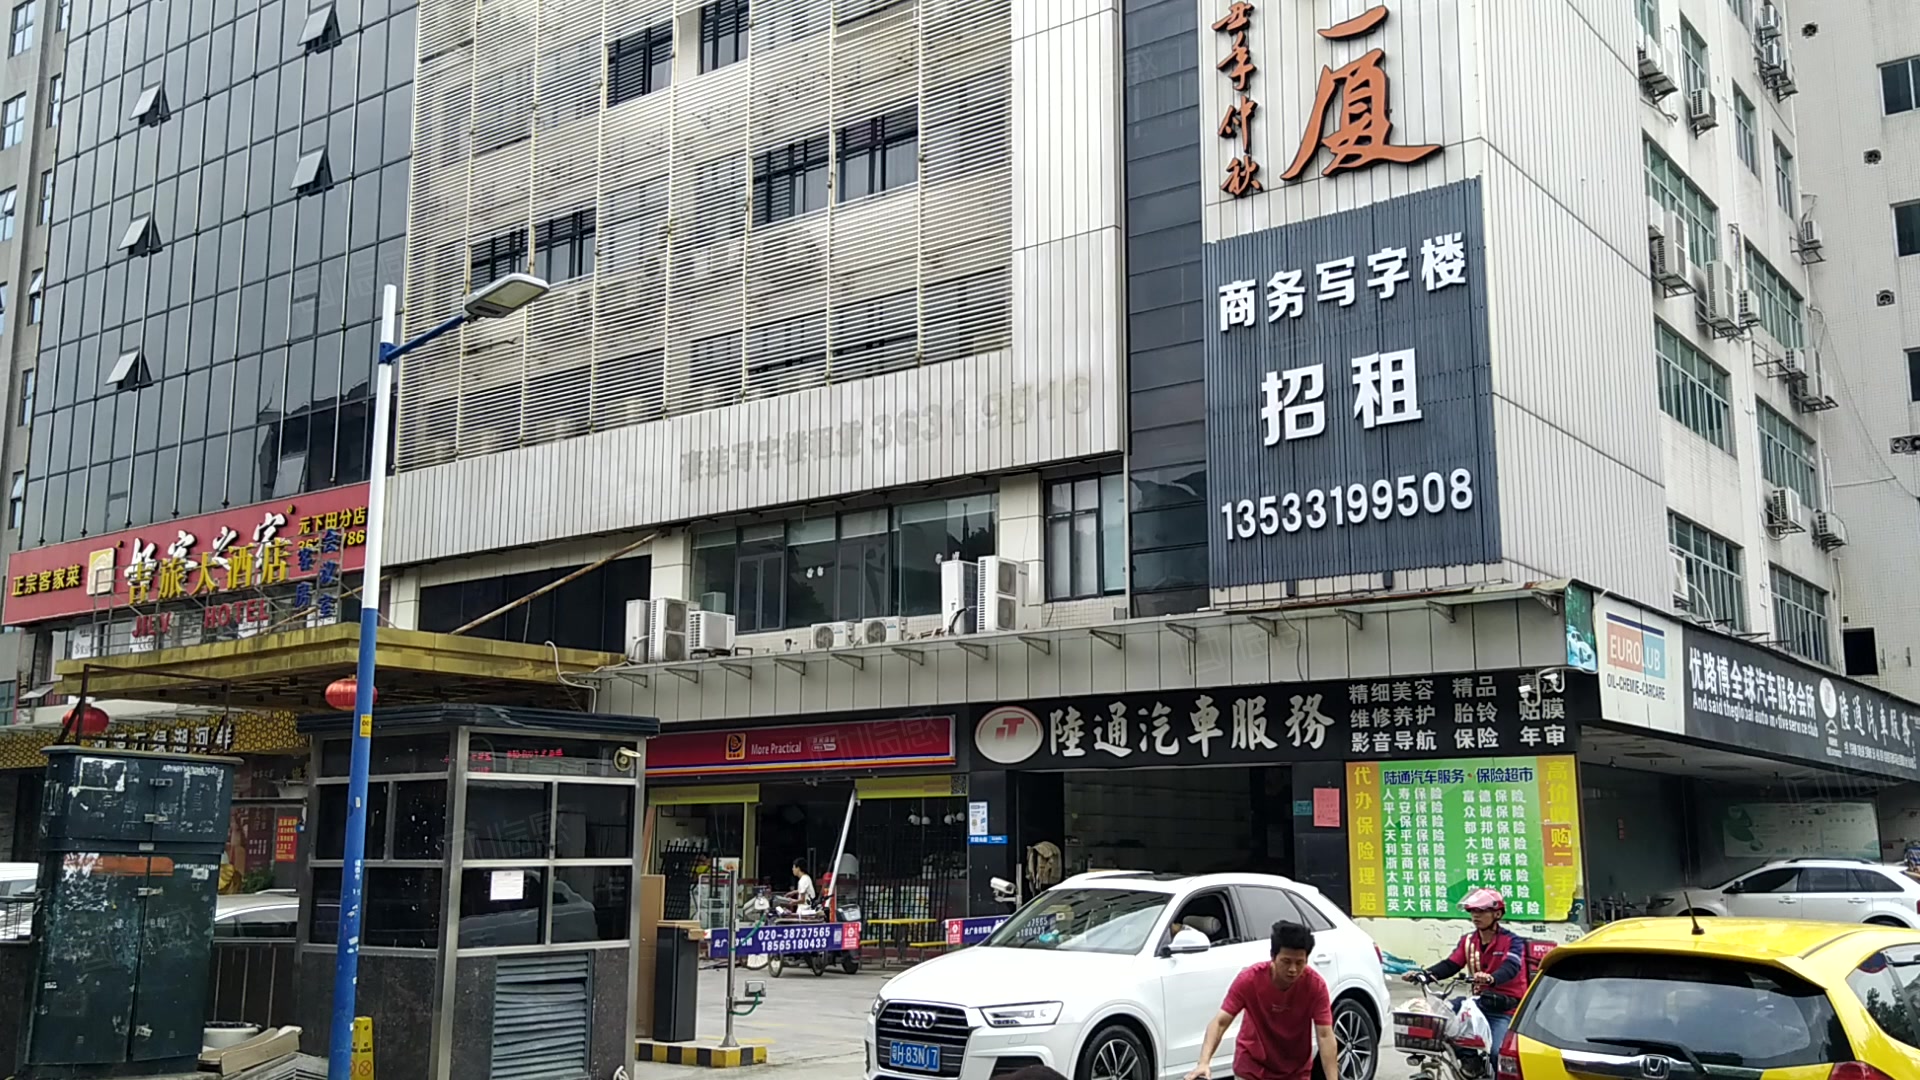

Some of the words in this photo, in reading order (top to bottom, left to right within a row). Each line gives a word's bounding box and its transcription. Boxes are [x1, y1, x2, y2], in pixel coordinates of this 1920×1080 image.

[1219, 231, 1467, 331] 商务写字楼
[1260, 347, 1423, 447] 招租
[1221, 467, 1473, 541] 13533199508
[298, 505, 366, 535] 元下田分店
[128, 537, 291, 605] 吉旅大酒店
[294, 546, 315, 608] 客房
[11, 564, 80, 597] 正宗客家菜
[204, 599, 269, 629] HOTEL
[1348, 678, 1435, 705] 精细美容
[1452, 675, 1498, 699] 精品
[1689, 646, 1817, 720] 优路博全球汽车服务会所
[1693, 691, 1708, 712] And
[1708, 696, 1723, 716] said
[1350, 704, 1436, 729] 维修养护
[1518, 698, 1566, 722] 贴膜
[1048, 694, 1336, 758] 陸通汽車服務
[1351, 730, 1437, 753] 影音导航
[1454, 727, 1499, 749] 保险
[1519, 724, 1566, 747] 年审
[751, 742, 770, 755] More
[770, 741, 802, 754] Practical
[1383, 787, 1442, 801] 人寿保险
[1462, 789, 1527, 803] 富德保险
[1383, 801, 1444, 815] 平安保险
[1463, 805, 1527, 819] 众诚保险
[1384, 814, 1444, 828] 人保保险
[1464, 820, 1527, 834] 都邦保险
[1354, 766, 1377, 911] 代办保险理赔
[1384, 828, 1445, 842] 天平保险
[1385, 842, 1446, 856] 利宝保险
[1464, 836, 1528, 850] 大地保险
[1385, 856, 1447, 870] 浙商保险
[1465, 852, 1529, 867] 华安保险
[1386, 870, 1447, 884] 太平保险
[1466, 867, 1530, 882] 阳光保险
[1387, 884, 1448, 898] 鼎和保险
[1387, 898, 1449, 912] 英大保险
[758, 927, 831, 941] 020-38737565
[761, 938, 827, 952] 18565180433
